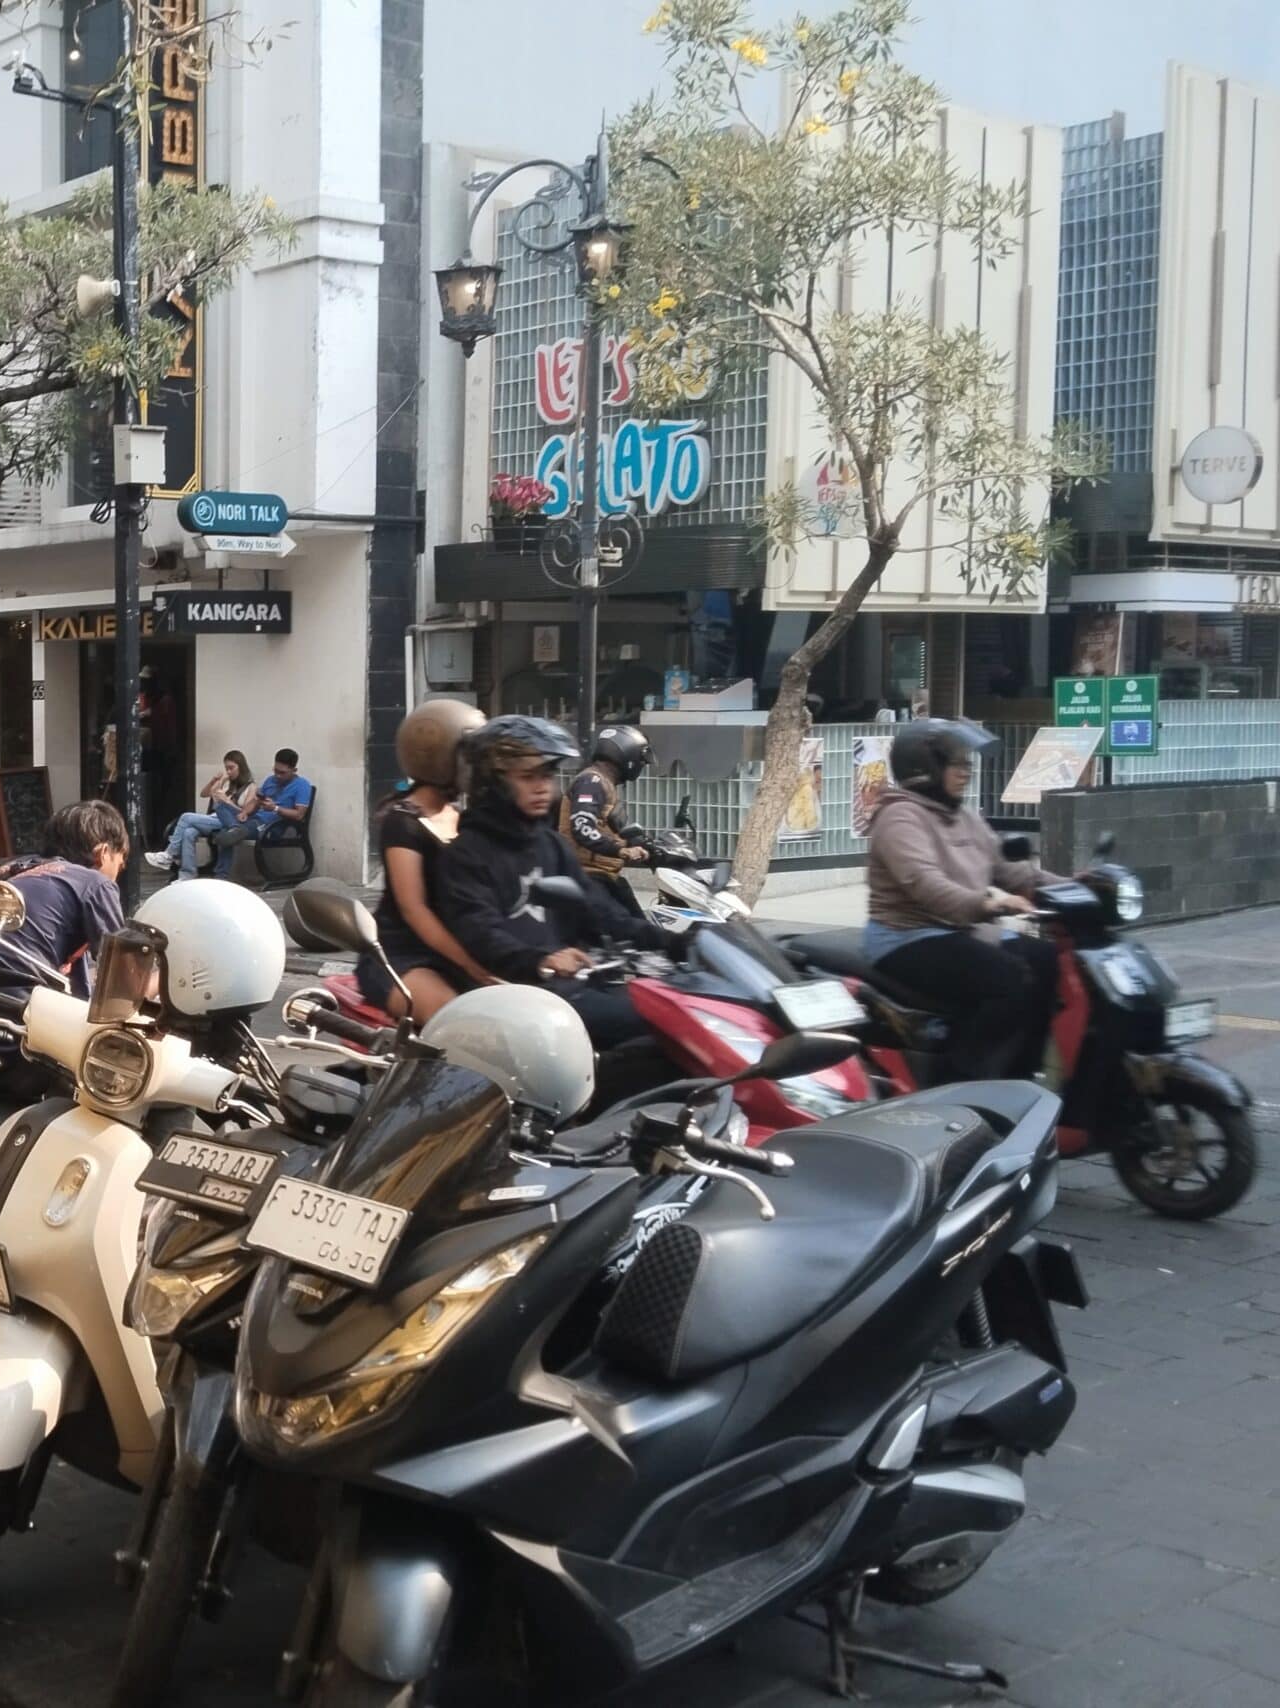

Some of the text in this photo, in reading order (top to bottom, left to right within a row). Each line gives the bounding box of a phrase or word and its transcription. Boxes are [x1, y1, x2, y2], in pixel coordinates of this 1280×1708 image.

[1190, 455, 1247, 475] TERVE
[218, 504, 279, 521] NORI TALK
[187, 603, 281, 621] KANIGARA
[182, 1145, 226, 1175] 3533
[230, 1155, 270, 1183] ABJ
[268, 1184, 399, 1243] F 3330 TAJ
